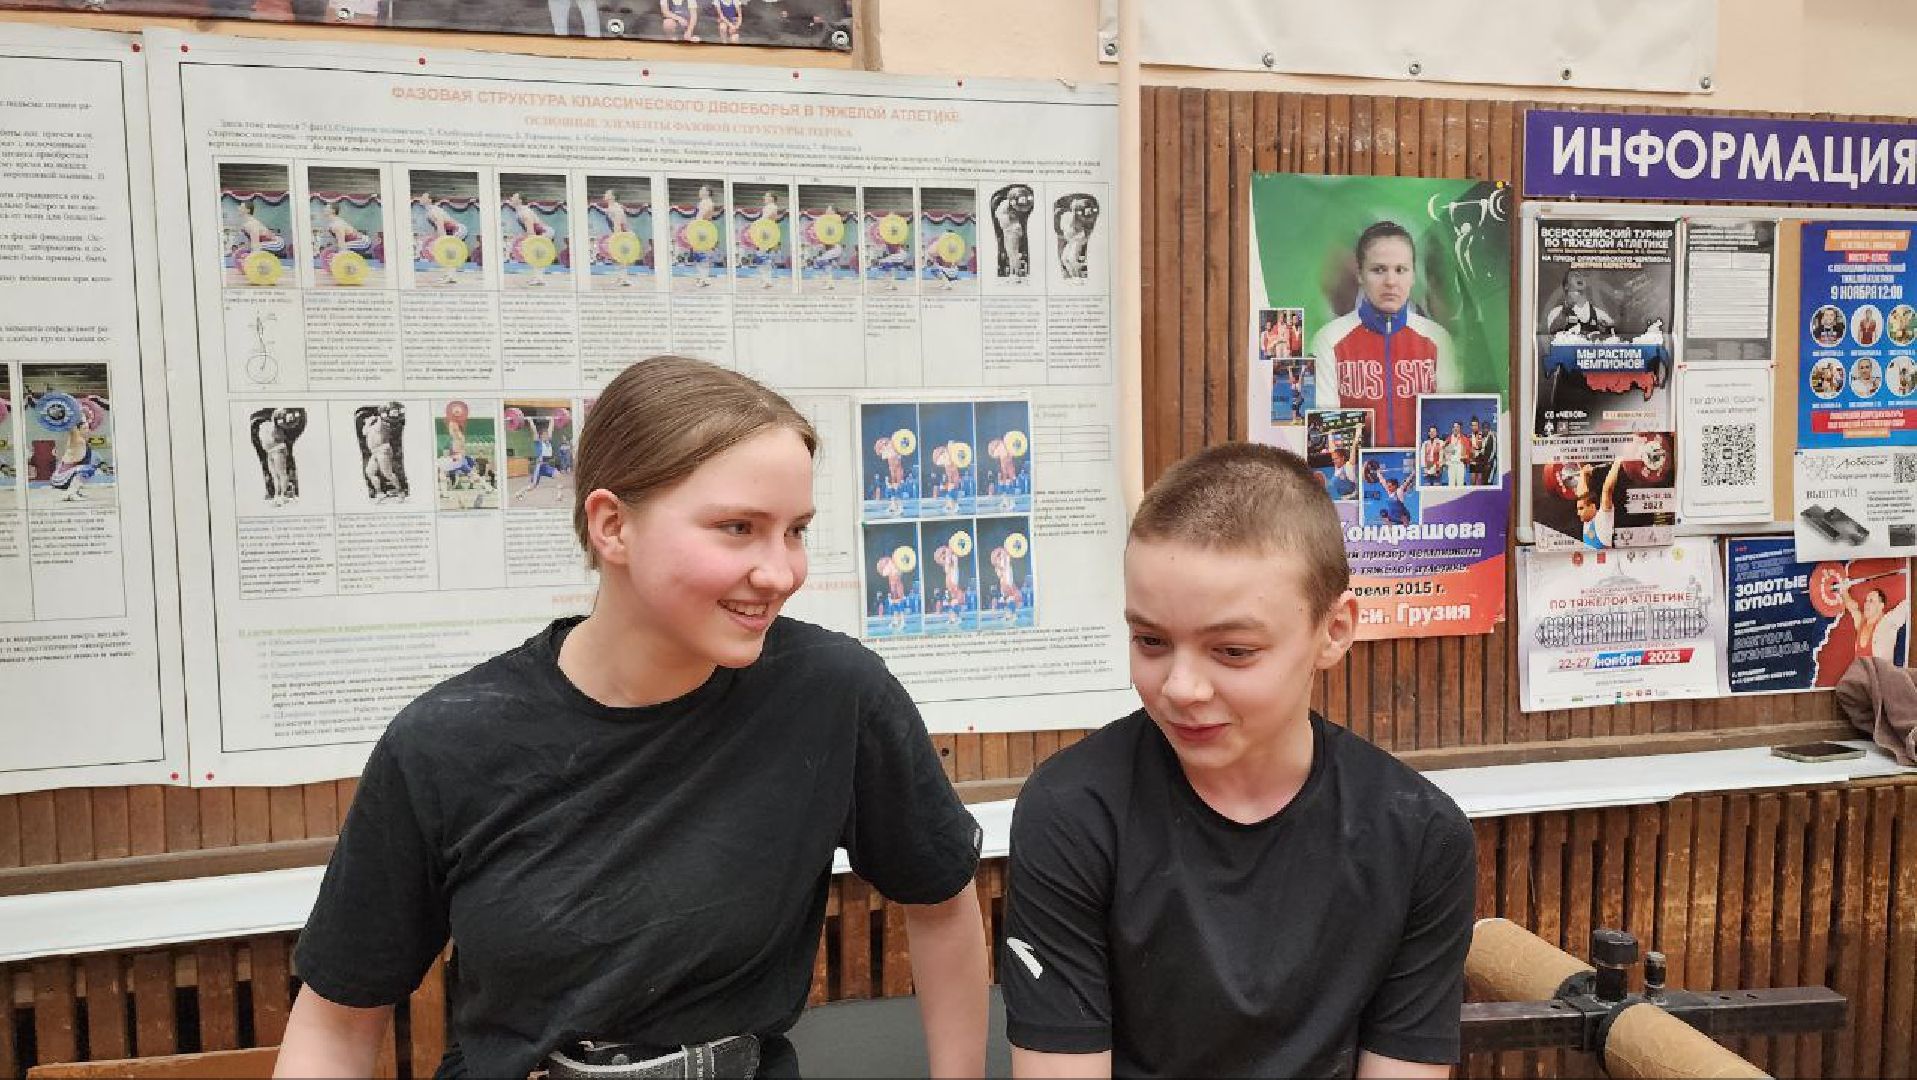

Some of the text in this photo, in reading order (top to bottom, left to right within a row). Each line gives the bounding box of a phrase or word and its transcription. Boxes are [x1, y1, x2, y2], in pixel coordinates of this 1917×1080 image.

[391, 86, 474, 103] ФАЗОВАЯ
[477, 91, 568, 108] СТРУКТУРА
[571, 96, 703, 114] КЛАССИЧЕСКОГО
[706, 100, 800, 118] ДВОЕБОРЬЯ
[804, 105, 814, 117] В
[819, 103, 886, 121] ТЯЖЕЛОЙ
[1552, 126, 1916, 189] ИНФОРМАЦИЯ
[1541, 226, 1673, 240] ВСЕРОССИЙСКИЙ ТУРНИР
[1544, 237, 1670, 249] ПО ТЯЖЕЛОЙ АТЛЕТИКЕ
[1830, 285, 1903, 299] 9 НОЯБРЯ 12:00
[1576, 348, 1642, 359] МЫ РАСТИМ
[1577, 359, 1645, 369] ЧЕМПИОНОВ!
[1361, 562, 1412, 575] тяжелой
[1350, 581, 1445, 597] реля 2015 г.
[1735, 574, 1808, 598] ЗОЛОТЫЕ
[1550, 592, 1691, 609] ПО ТЯЖЕЛОЙ АТЛЕТИКЕ
[1735, 591, 1794, 612] КУПОЛА
[1397, 602, 1471, 627] Грузия
[1734, 630, 1793, 650] ВИКТОРА
[1558, 650, 1681, 670] 22-27 ноября 2023
[1732, 641, 1810, 663] КУЗНЕЦОВА
